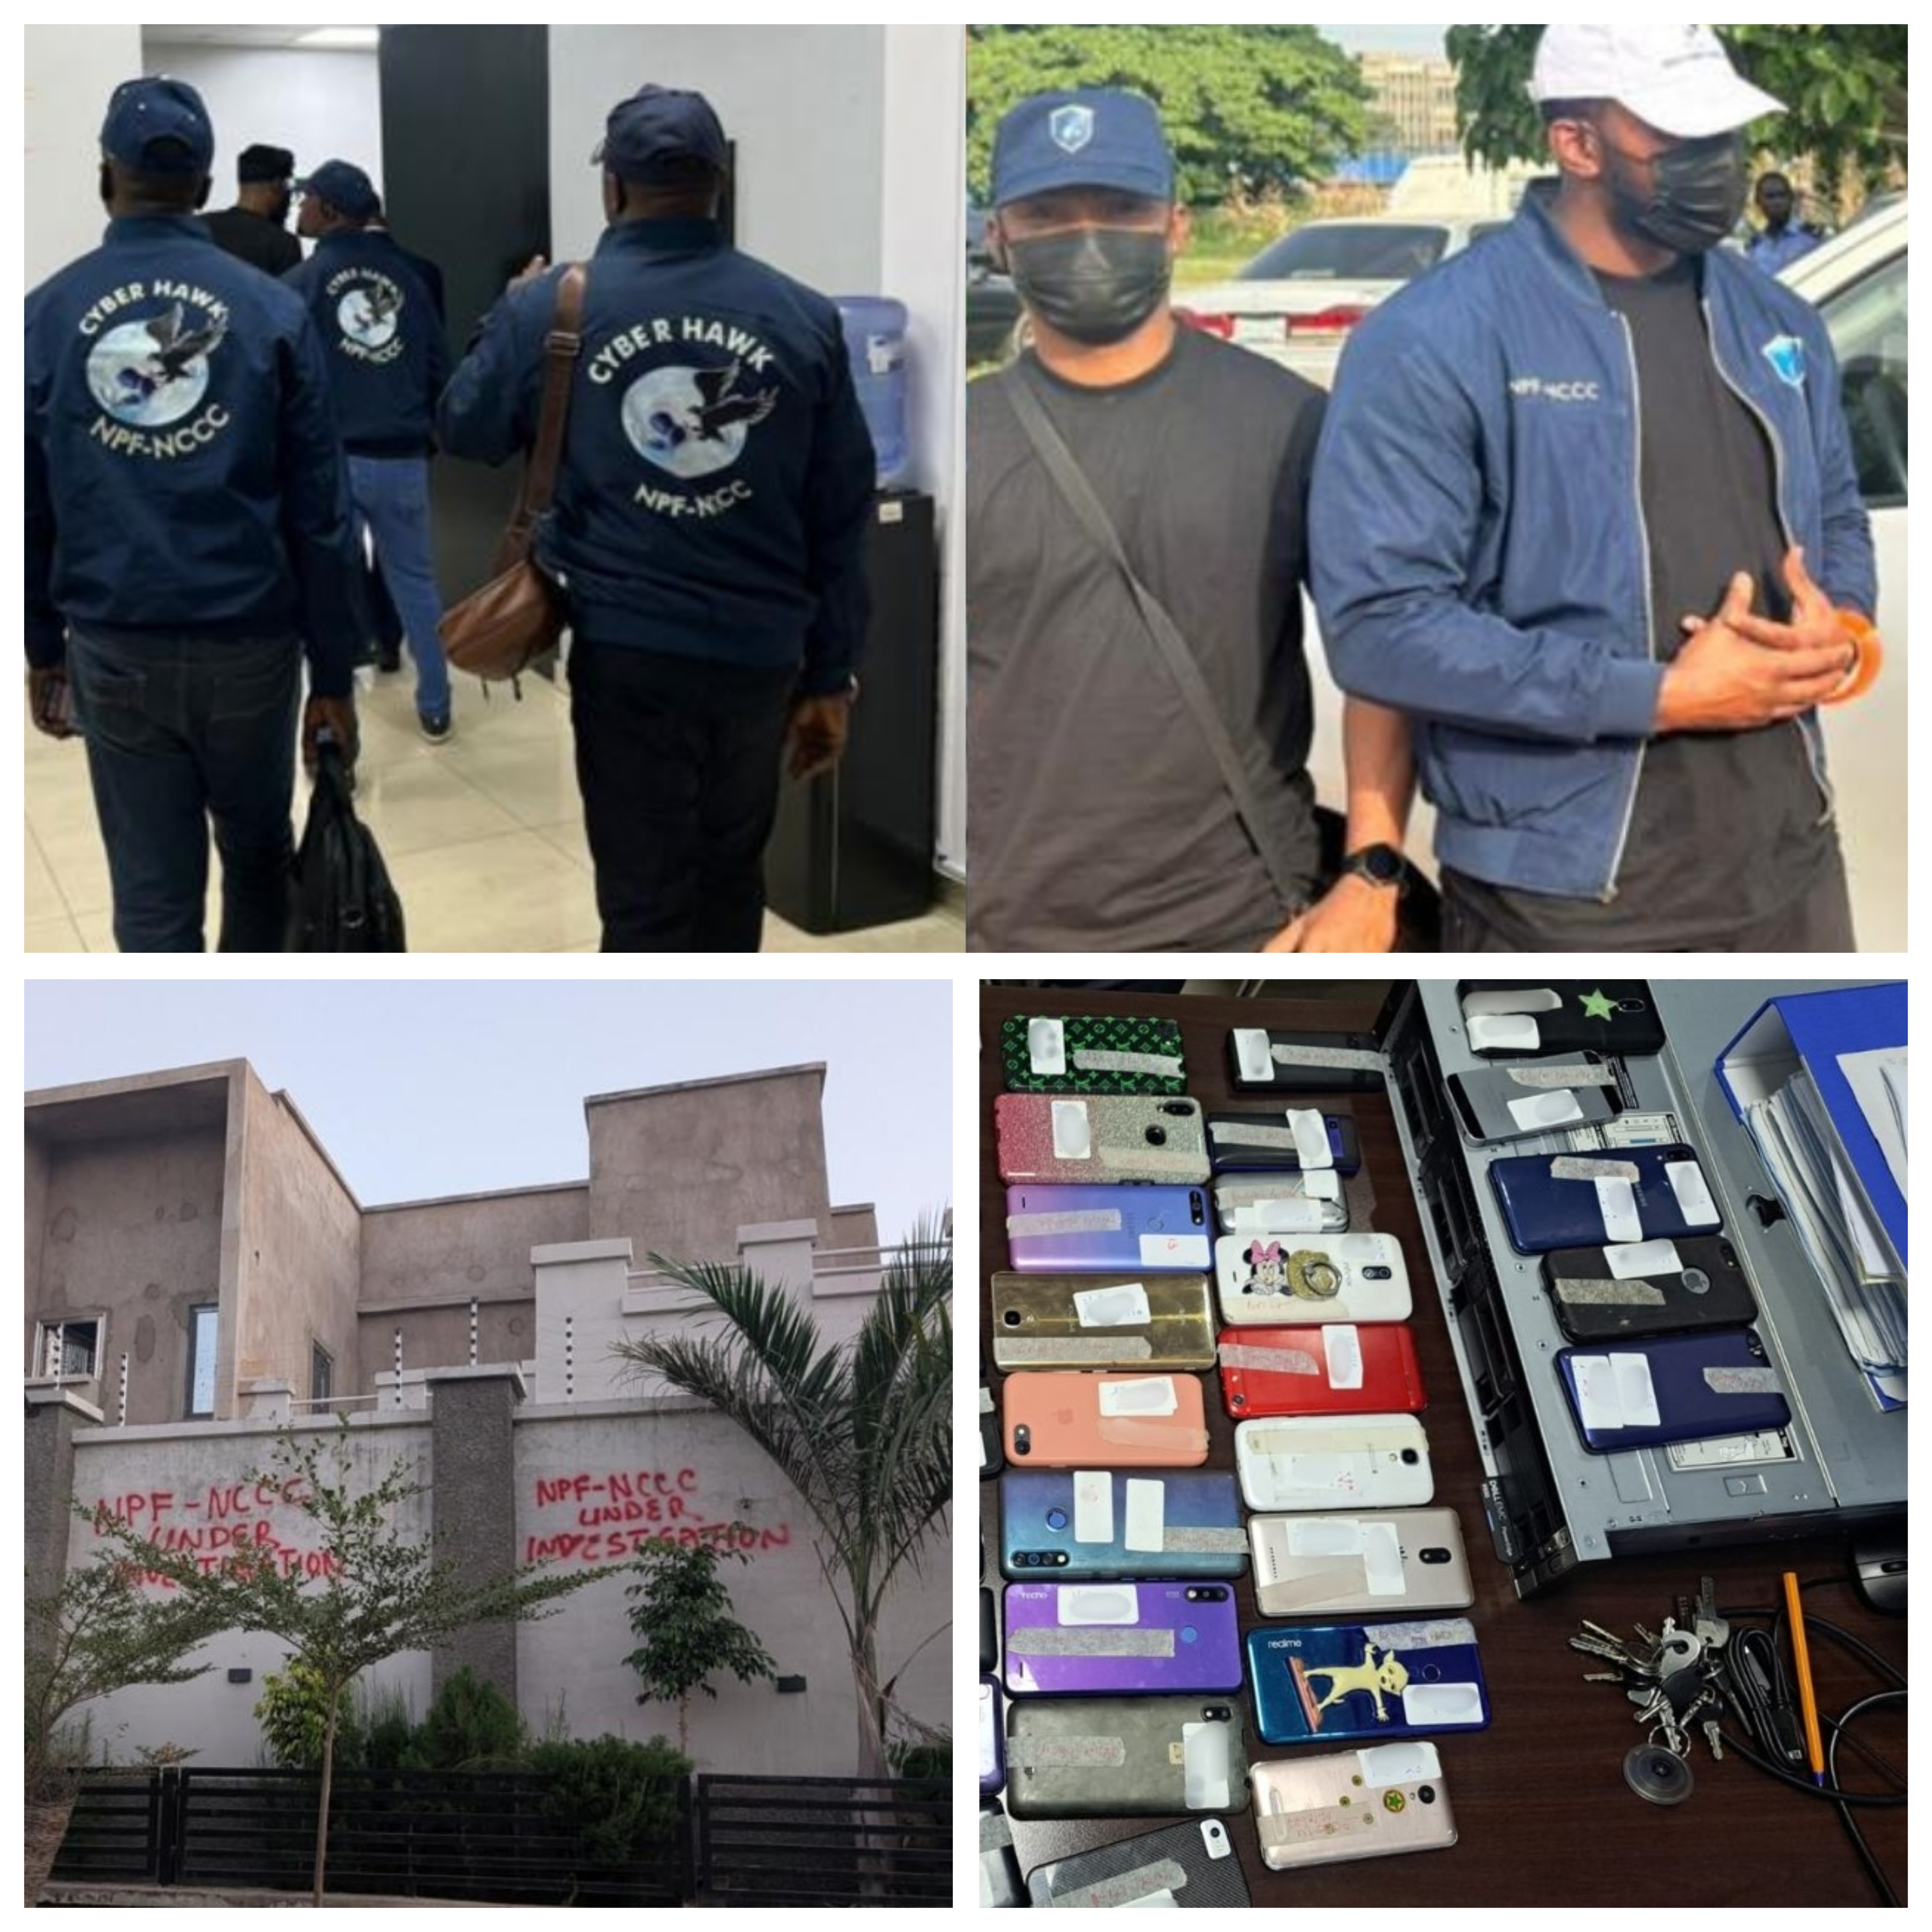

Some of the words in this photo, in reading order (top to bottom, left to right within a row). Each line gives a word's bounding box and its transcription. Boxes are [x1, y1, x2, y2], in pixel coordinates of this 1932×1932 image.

[78, 283, 145, 337] CYBER
[153, 280, 228, 318] HAWK
[588, 319, 672, 383] CYBER
[682, 317, 775, 372] HAWK
[90, 403, 230, 460] NPF-NCCC
[536, 1469, 697, 1507] NPF-NCCC
[578, 1497, 703, 1527] UNDER
[149, 1520, 280, 1552] UNDER
